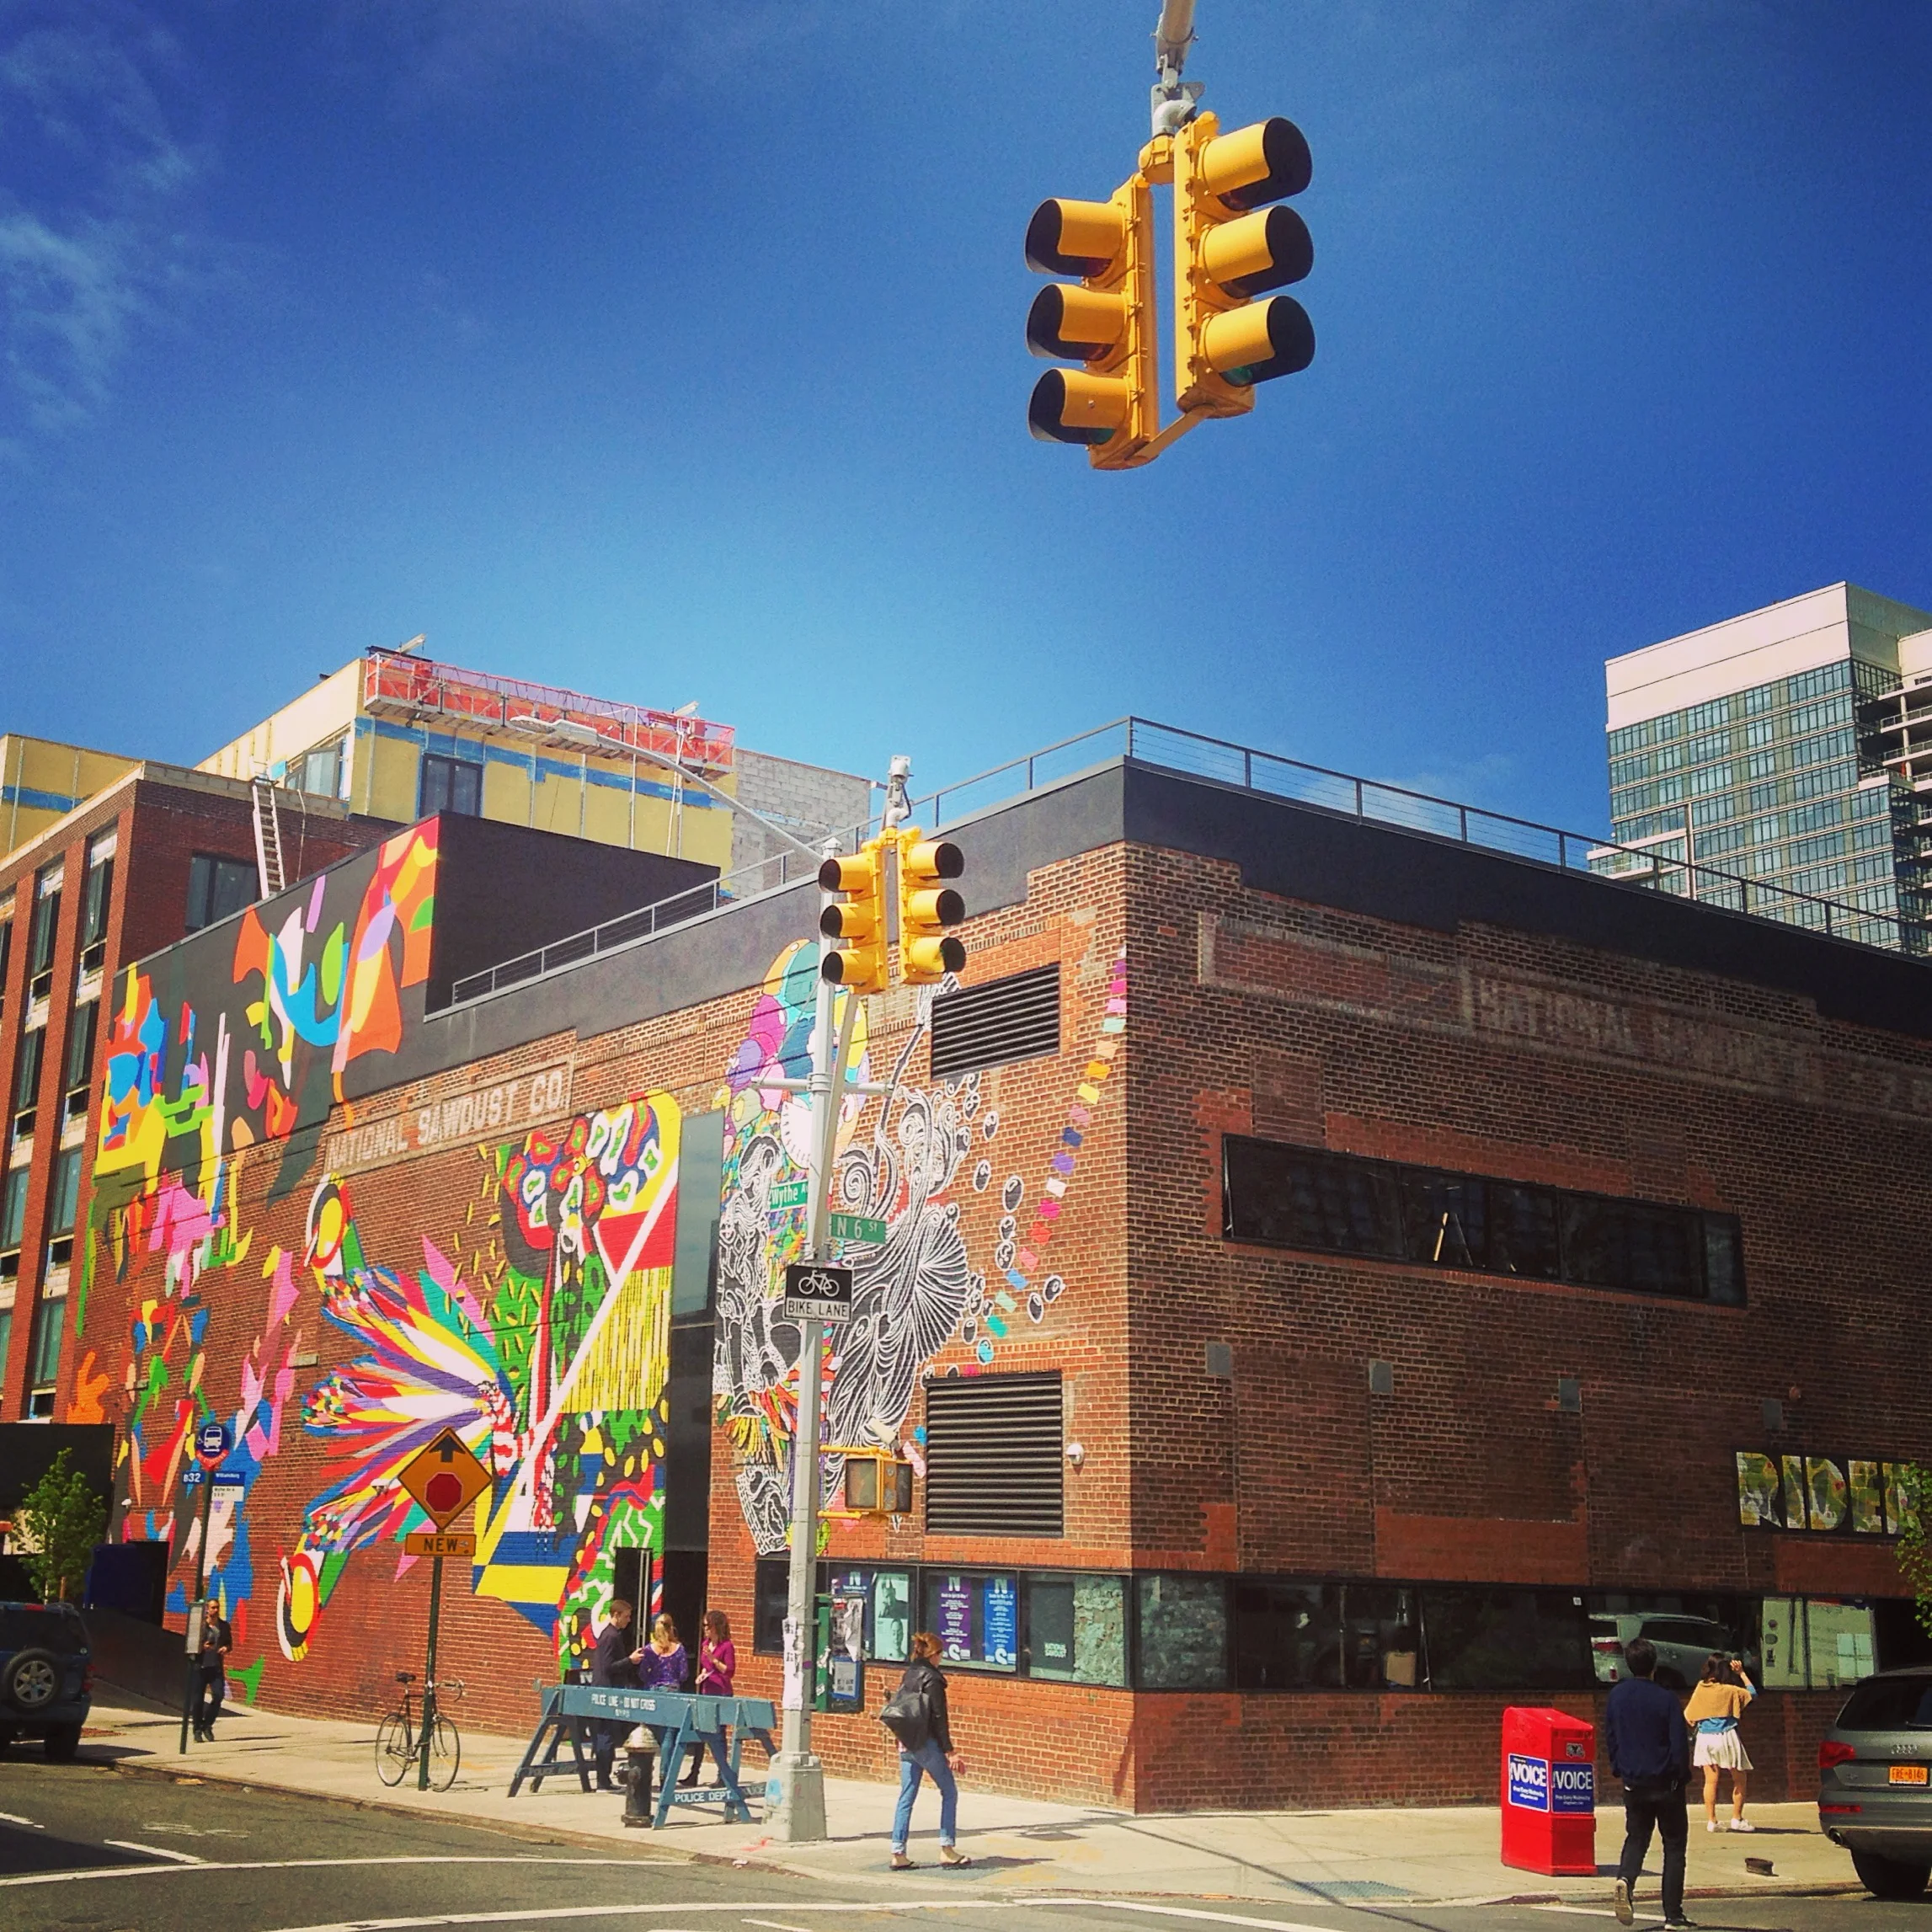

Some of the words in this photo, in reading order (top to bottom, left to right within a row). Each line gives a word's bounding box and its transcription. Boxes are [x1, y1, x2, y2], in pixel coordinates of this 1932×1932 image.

[328, 1120, 408, 1169] NATIONAL
[418, 1084, 517, 1145] SAWDUST
[771, 1186, 798, 1208] Wythe
[837, 1217, 847, 1237] N
[854, 1221, 862, 1239] 6
[868, 1222, 878, 1232] St
[788, 1300, 813, 1315] BIKE
[819, 1303, 847, 1318] LANE
[183, 1473, 201, 1482] B32
[424, 1538, 458, 1552] NEW
[591, 1693, 606, 1706] POLICE
[608, 1695, 619, 1707] LINE
[675, 1792, 705, 1802] POLICE
[708, 1791, 734, 1801] DEPT.
